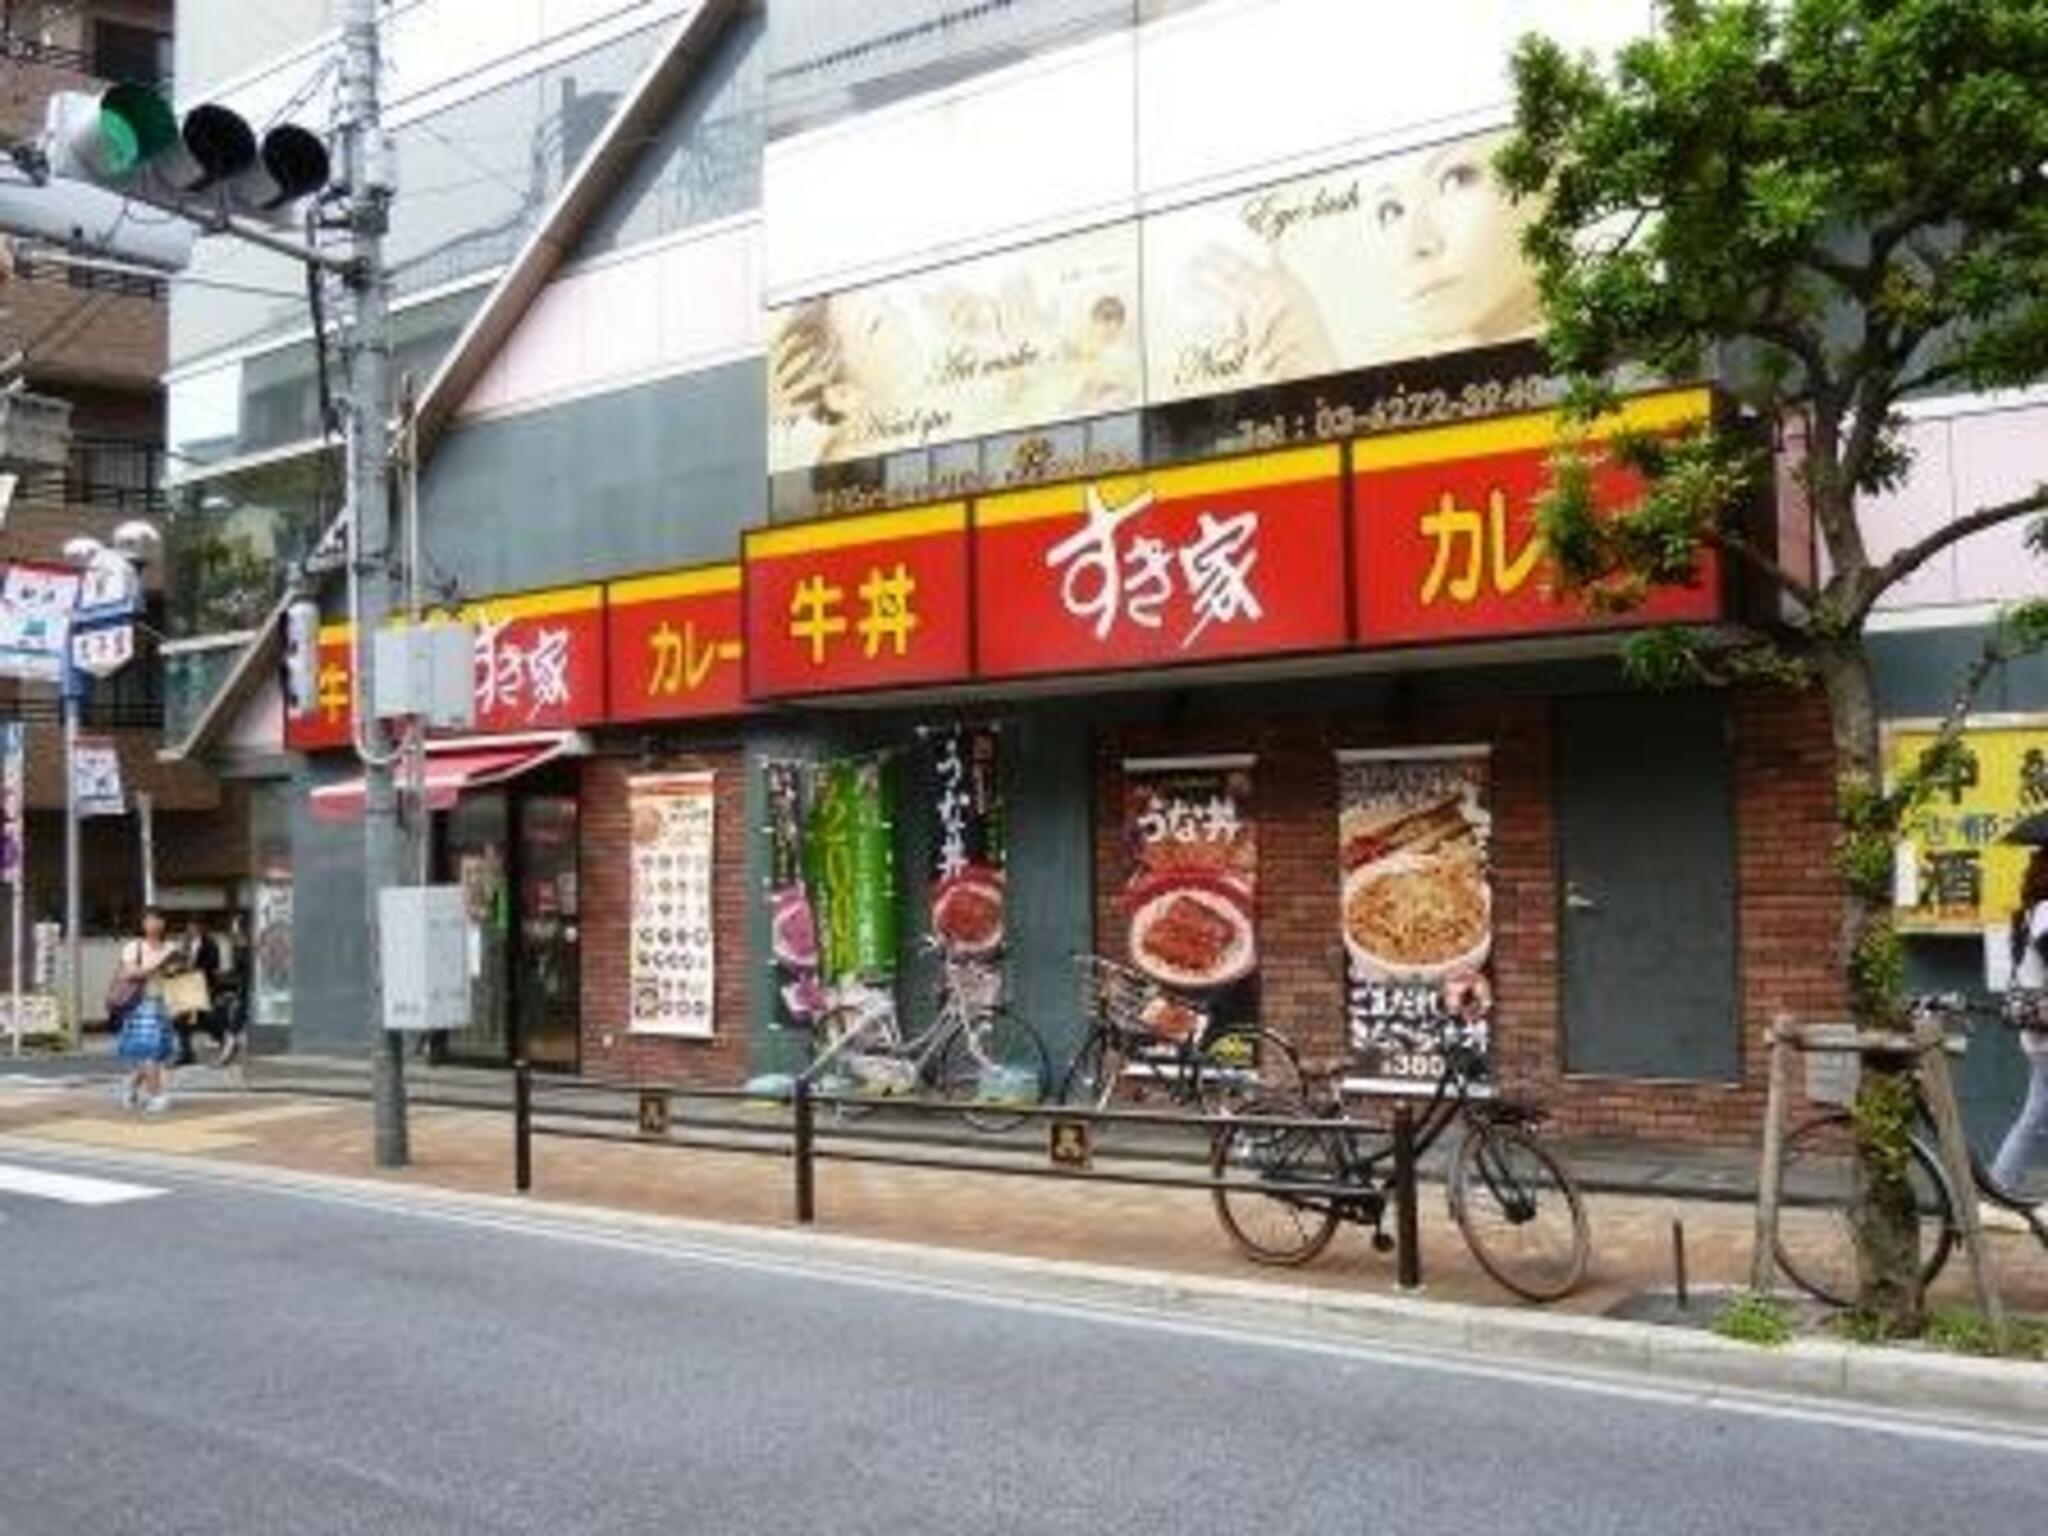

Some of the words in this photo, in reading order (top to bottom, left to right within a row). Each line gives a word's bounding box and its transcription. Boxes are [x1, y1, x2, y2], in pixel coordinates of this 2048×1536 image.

[1046, 484, 1263, 650] すき家
[1420, 490, 1550, 604] カレ
[648, 621, 743, 695] カレー
[790, 563, 917, 663] 牛丼
[319, 663, 349, 723] 牛
[474, 611, 571, 722] すき家
[1136, 795, 1242, 843] うな丼
